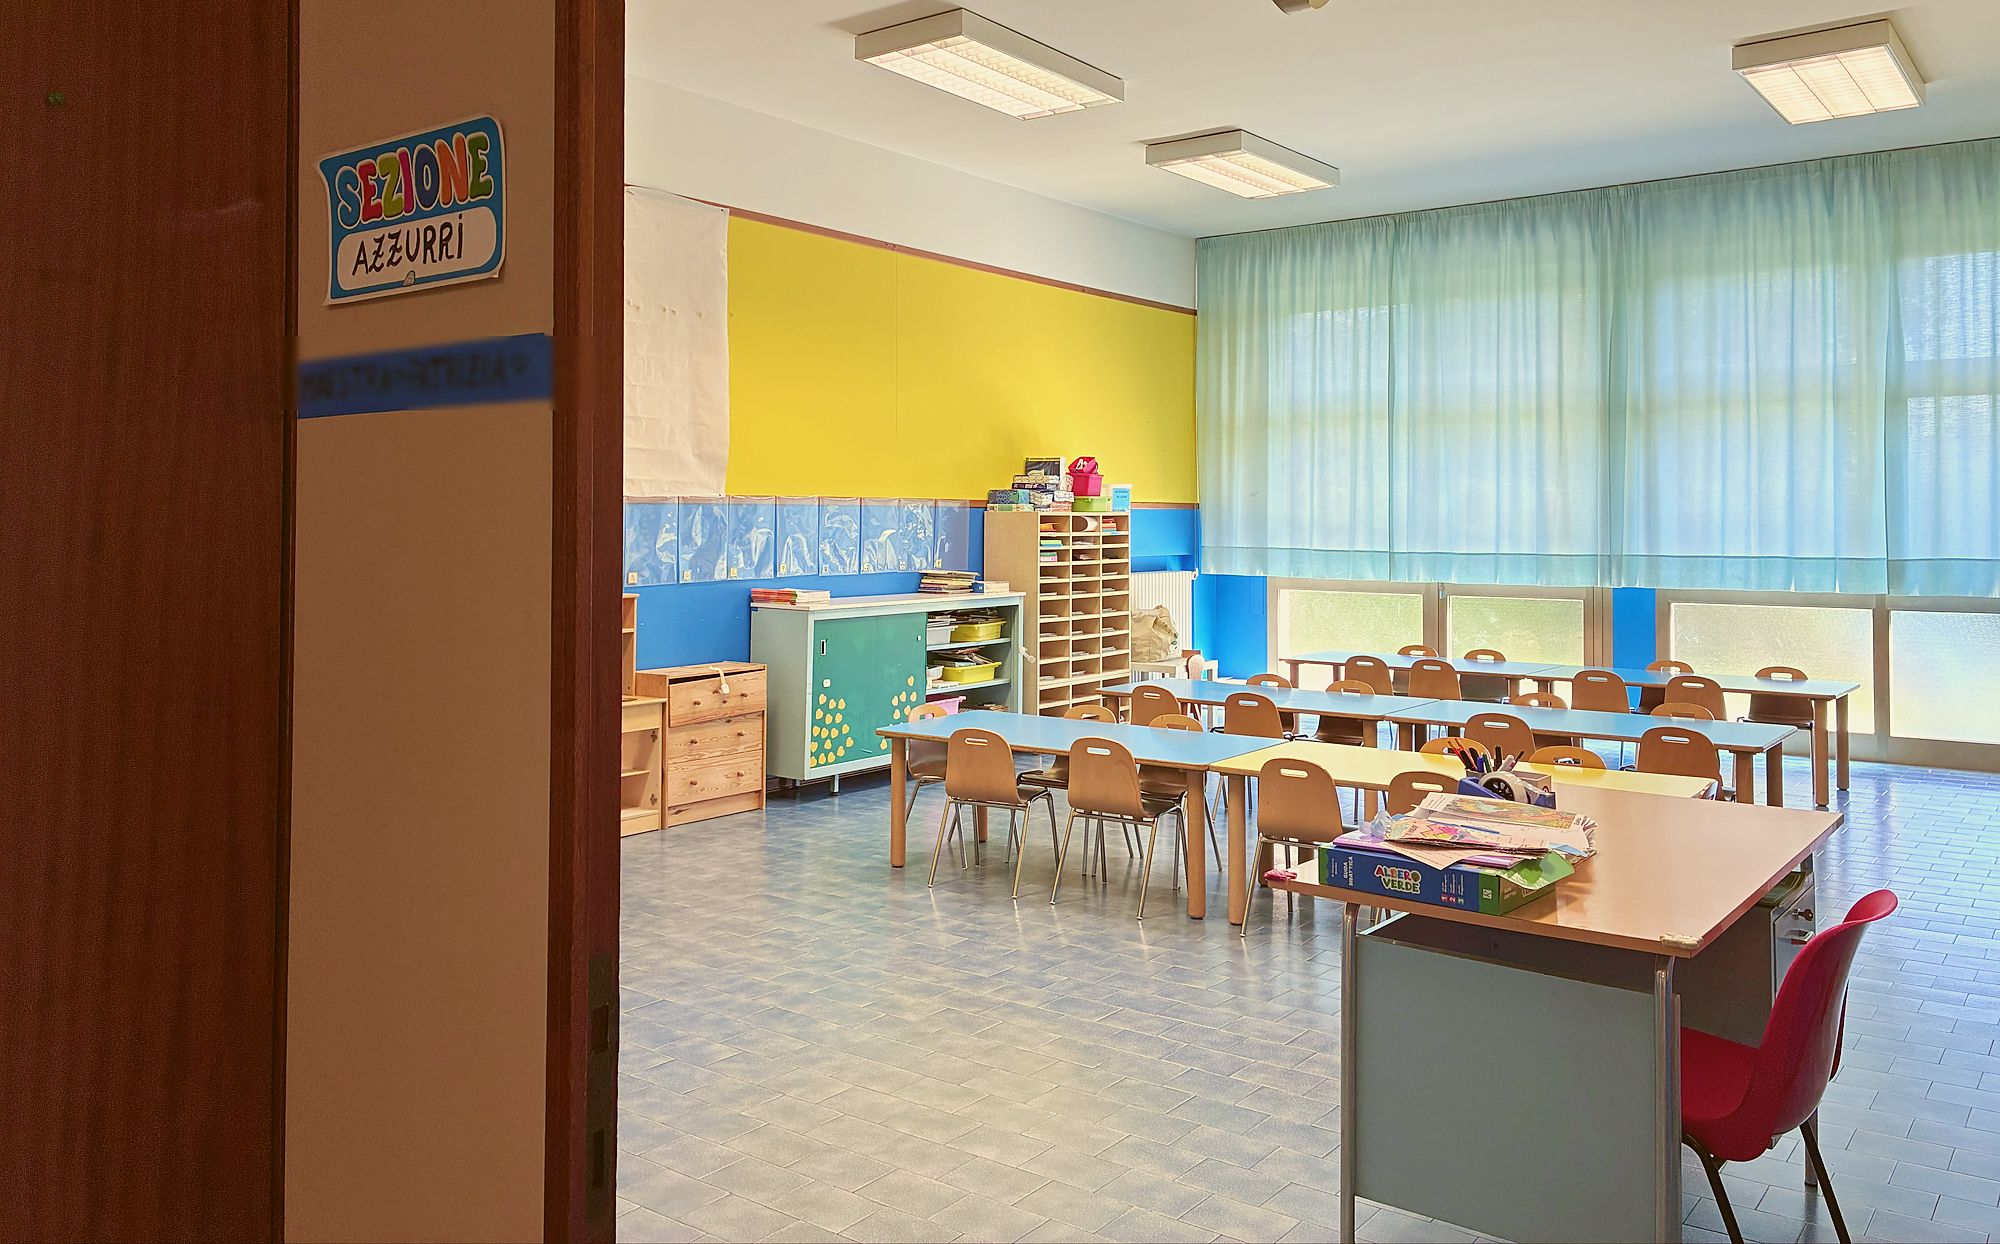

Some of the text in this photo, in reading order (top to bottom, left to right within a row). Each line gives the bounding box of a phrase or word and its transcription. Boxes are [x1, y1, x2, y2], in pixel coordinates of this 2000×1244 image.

[336, 132, 493, 229] SEZIONE
[352, 213, 464, 276] AZZURRI
[1374, 865, 1422, 883] ALBERO
[1382, 877, 1421, 894] VERDE
